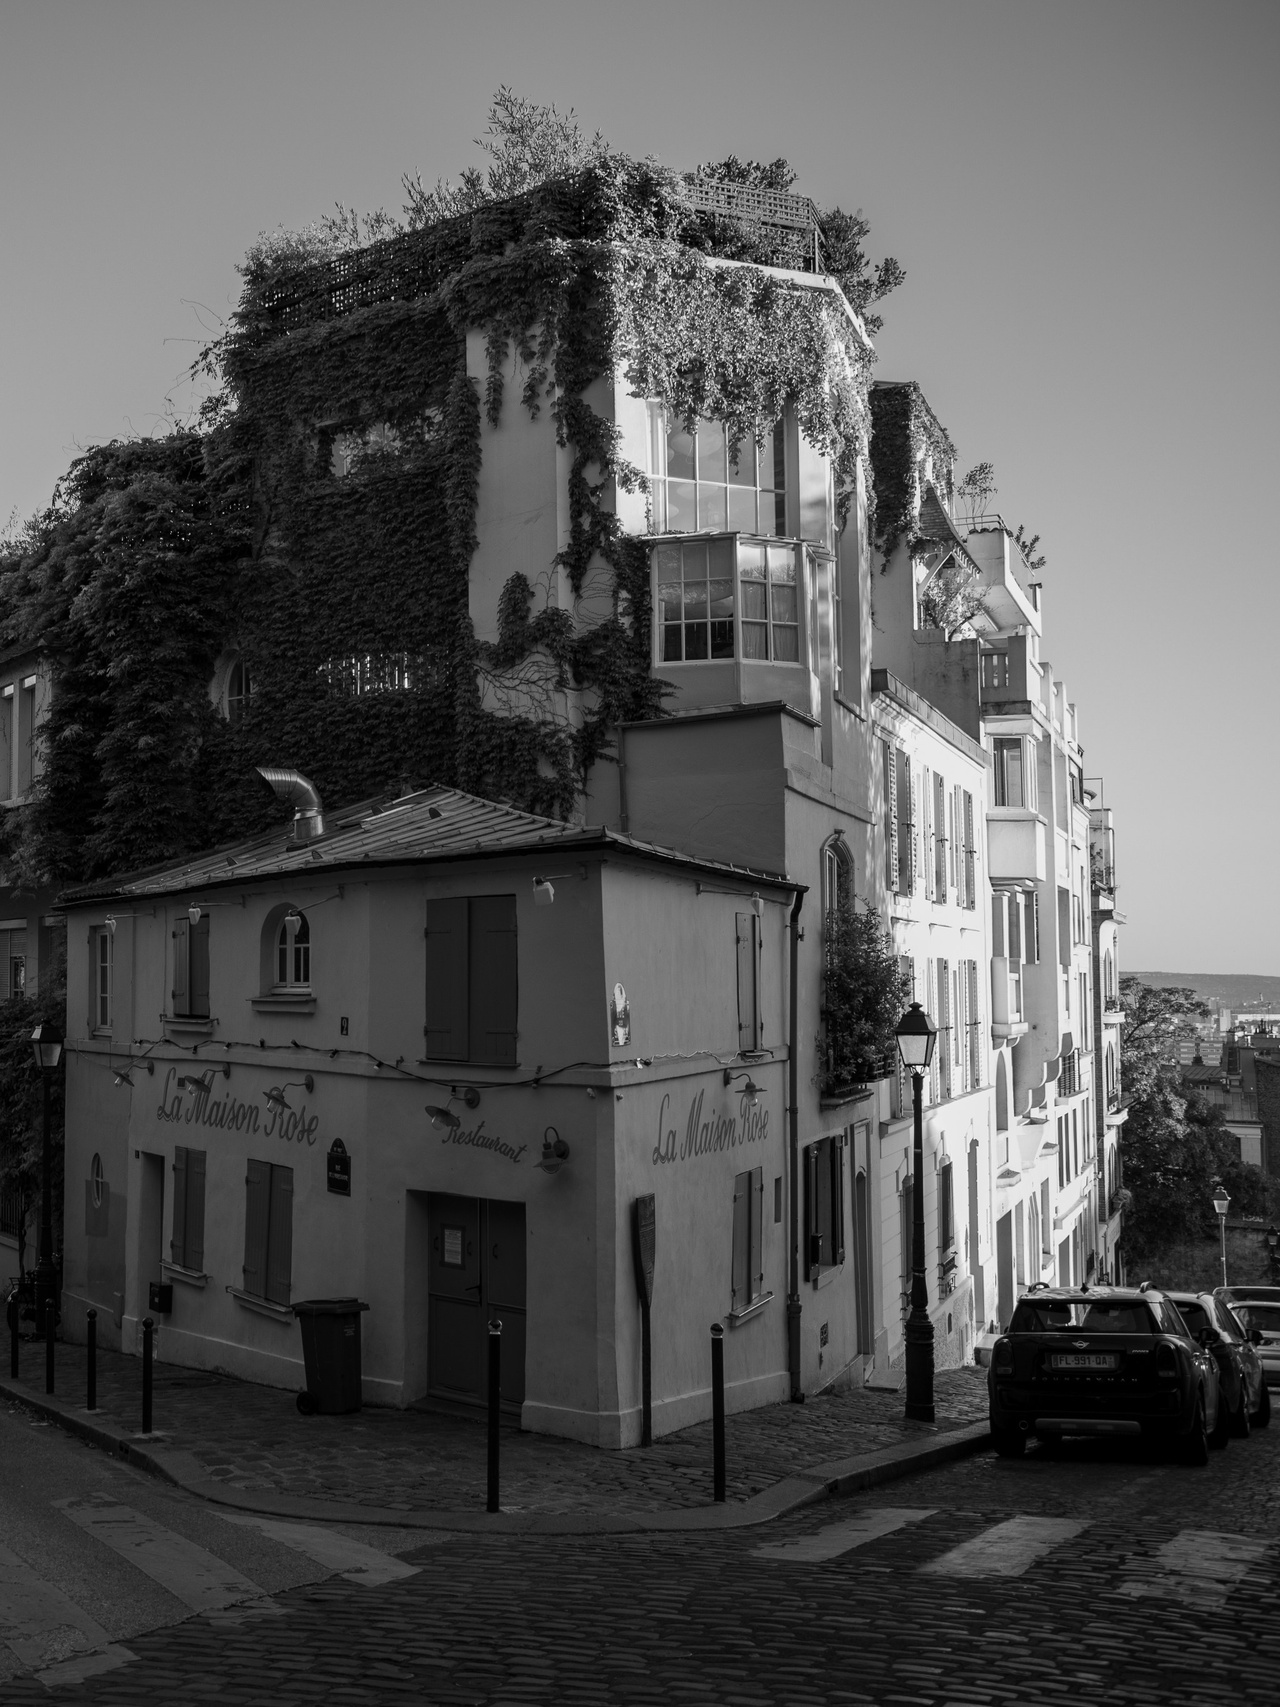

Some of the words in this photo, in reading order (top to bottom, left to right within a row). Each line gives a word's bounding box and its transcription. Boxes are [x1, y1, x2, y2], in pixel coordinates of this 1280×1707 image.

[157, 1067, 183, 1122] La
[185, 1071, 260, 1134] Maison
[264, 1087, 319, 1146] Rose
[442, 1116, 528, 1163] Restaurant
[652, 1093, 677, 1165] La
[680, 1088, 736, 1161] Maison
[738, 1093, 768, 1145] Rose
